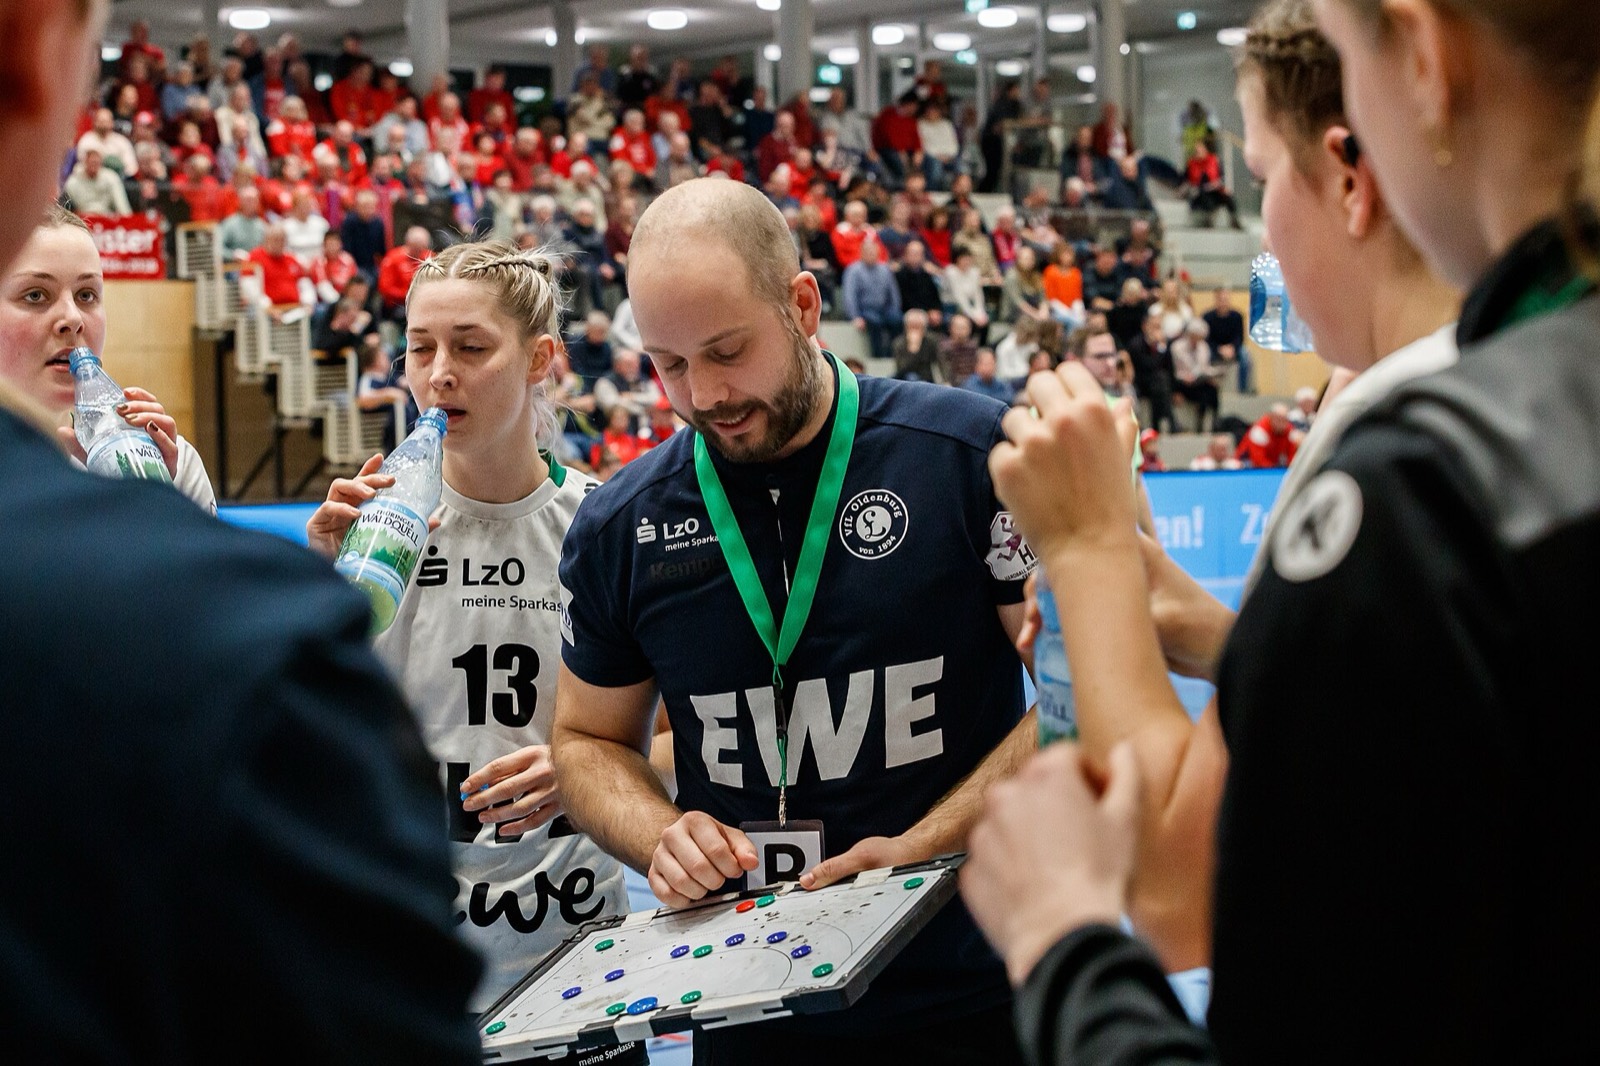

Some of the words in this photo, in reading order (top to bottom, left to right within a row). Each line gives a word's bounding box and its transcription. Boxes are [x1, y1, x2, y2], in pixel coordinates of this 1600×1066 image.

[362, 513, 418, 547] WALDQUELL
[663, 518, 699, 540] LzO
[844, 515, 853, 537] VfL
[851, 494, 903, 518] Oldenburg
[665, 541, 690, 552] meine
[859, 546, 874, 555] von
[878, 535, 896, 553] 1894
[462, 557, 525, 586] LzO
[462, 595, 505, 608] meine
[452, 643, 540, 728] 13
[690, 655, 944, 788] EWE
[453, 867, 605, 933] we
